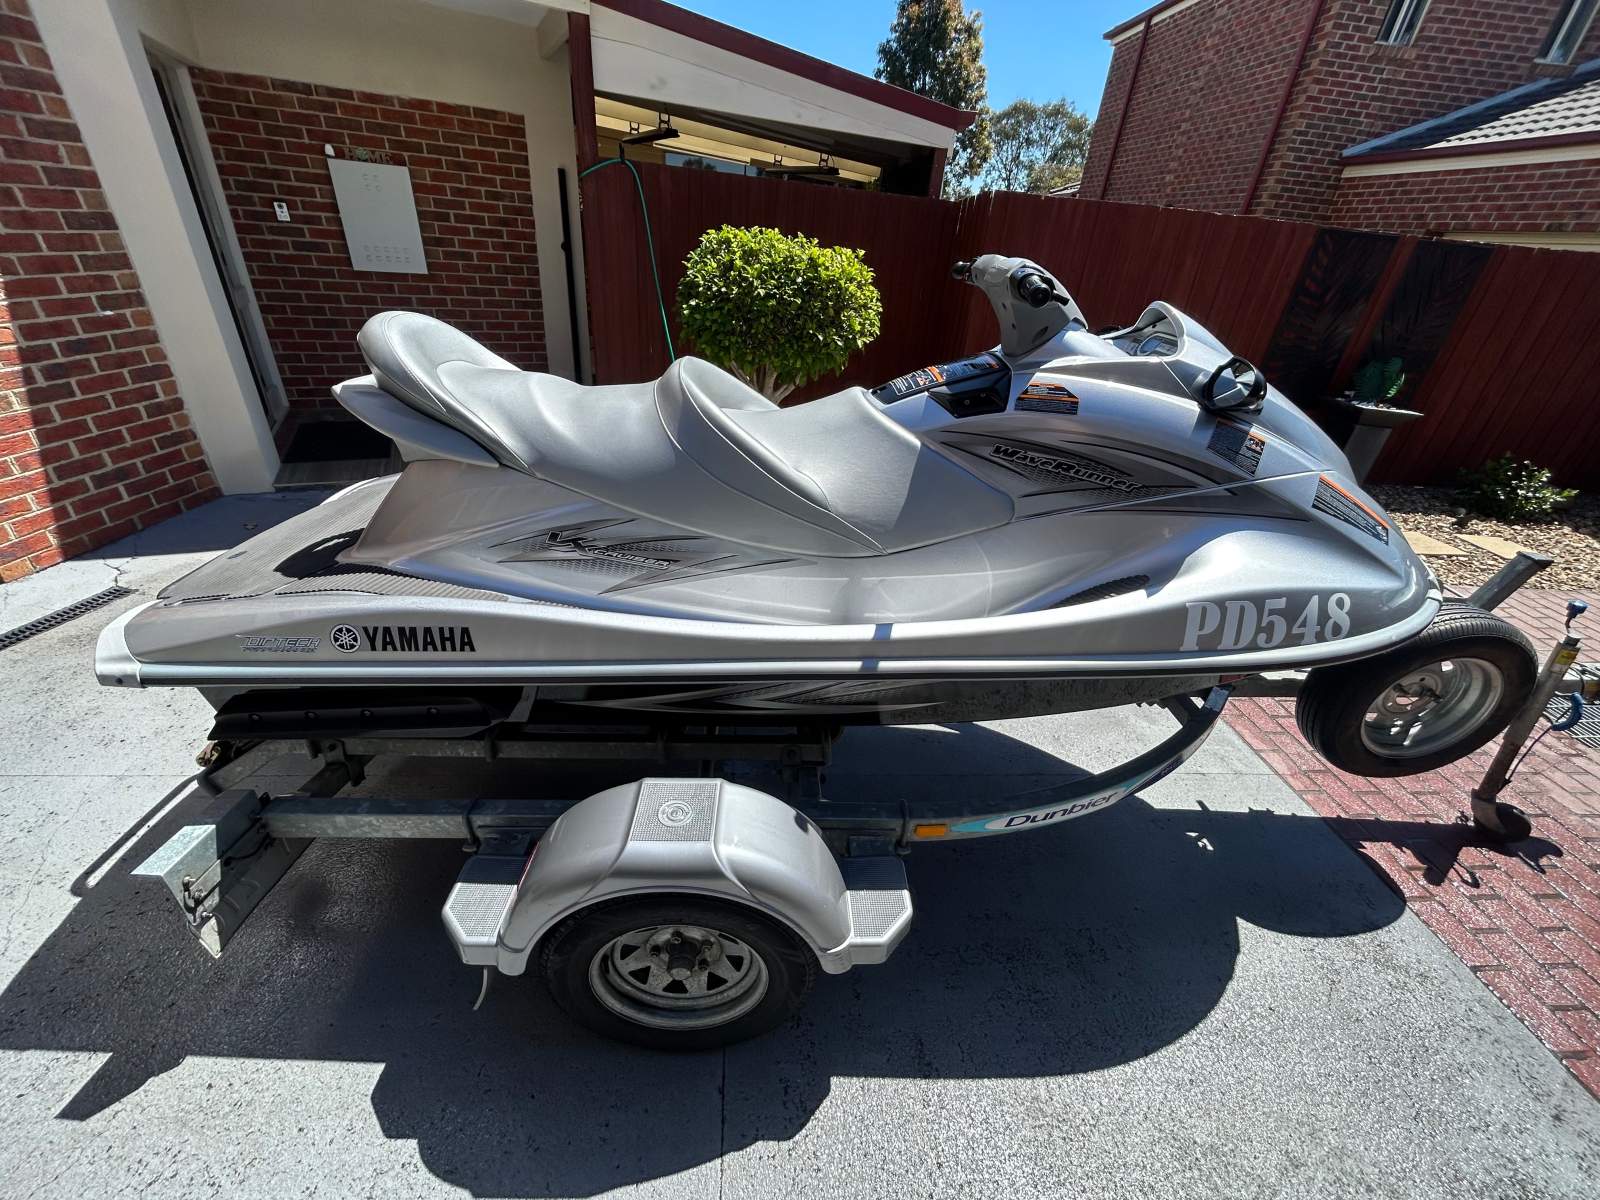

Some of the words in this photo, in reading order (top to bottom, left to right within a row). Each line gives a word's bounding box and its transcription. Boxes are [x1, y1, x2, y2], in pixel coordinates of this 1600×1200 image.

[990, 444, 1144, 492] WaveRunner
[361, 626, 476, 652] YAMAHA
[1180, 592, 1351, 651] PD548
[1004, 791, 1118, 828] Dunbier
